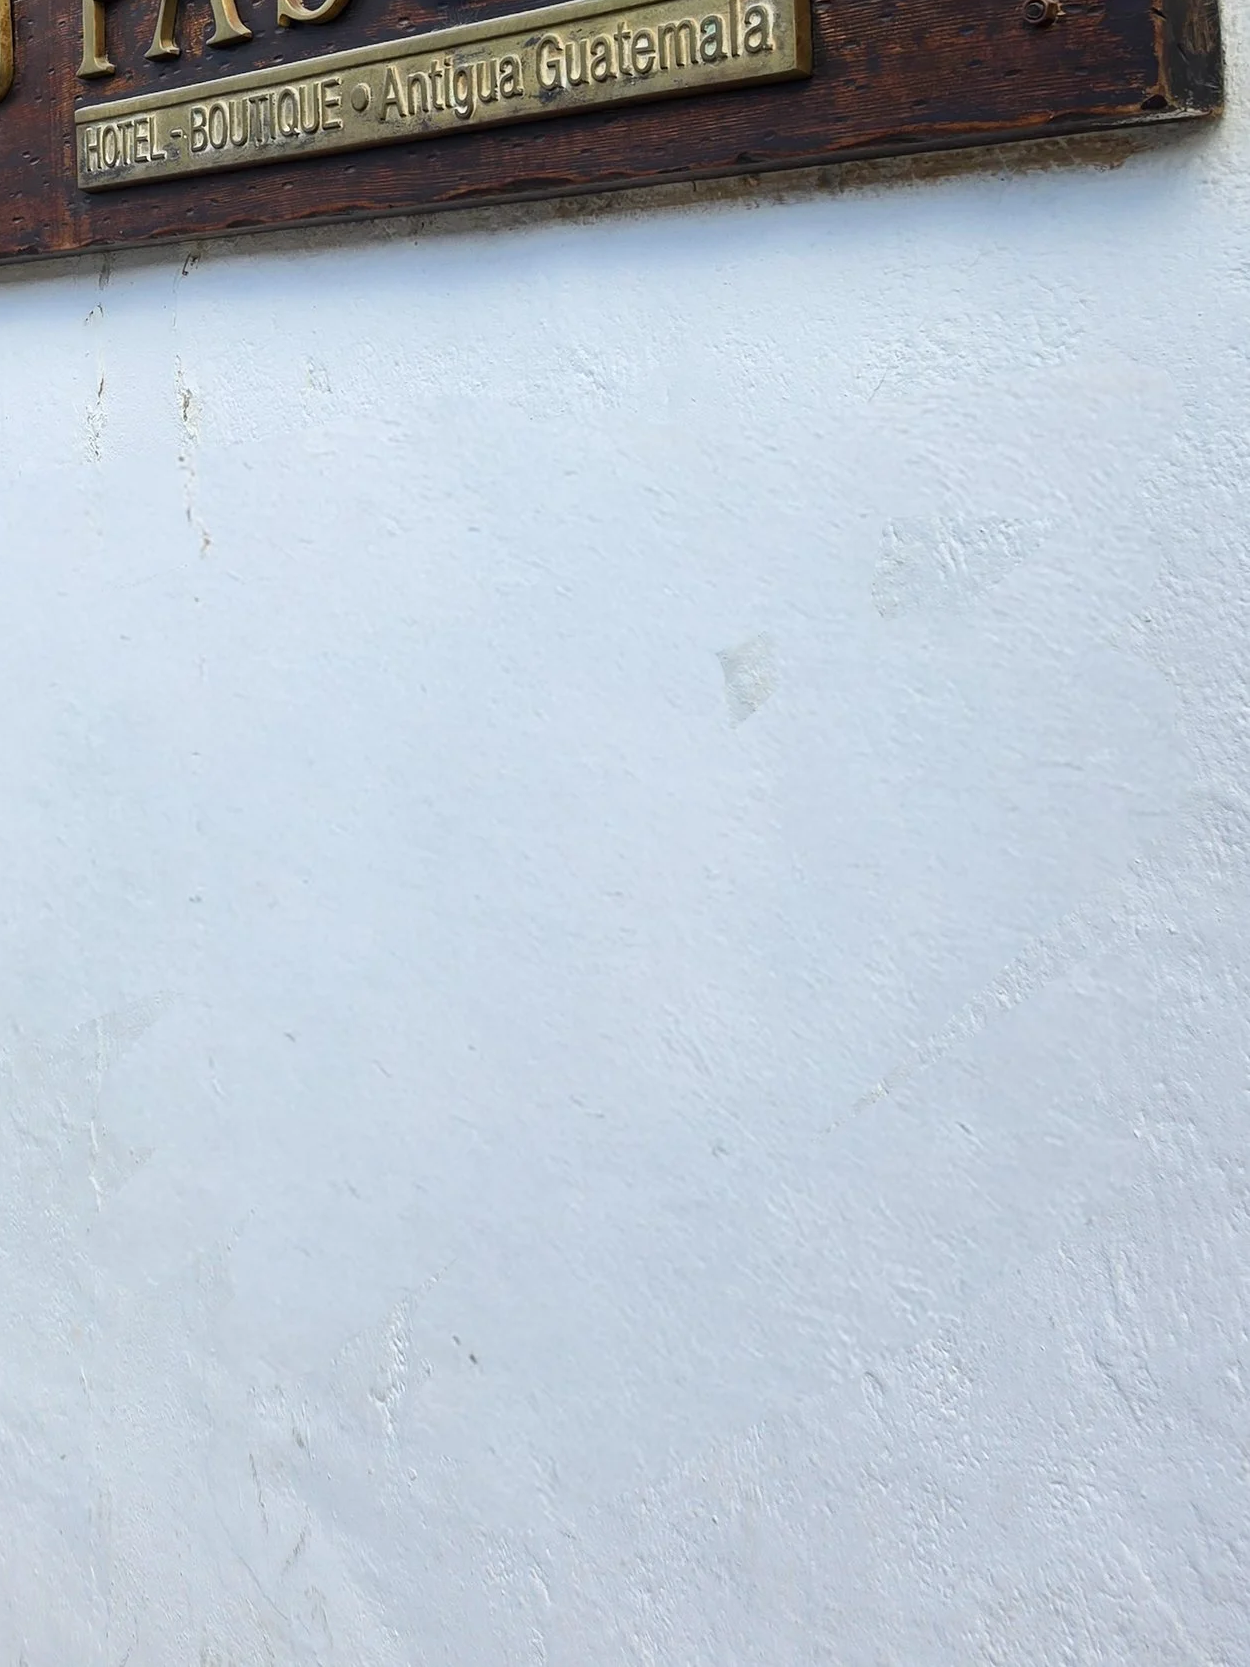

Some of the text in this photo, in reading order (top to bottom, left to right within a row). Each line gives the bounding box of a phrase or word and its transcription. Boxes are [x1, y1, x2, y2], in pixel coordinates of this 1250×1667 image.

[85, 116, 167, 172] HOTEL
[188, 79, 344, 153] BOUTIQUE
[379, 63, 525, 120] Antigua
